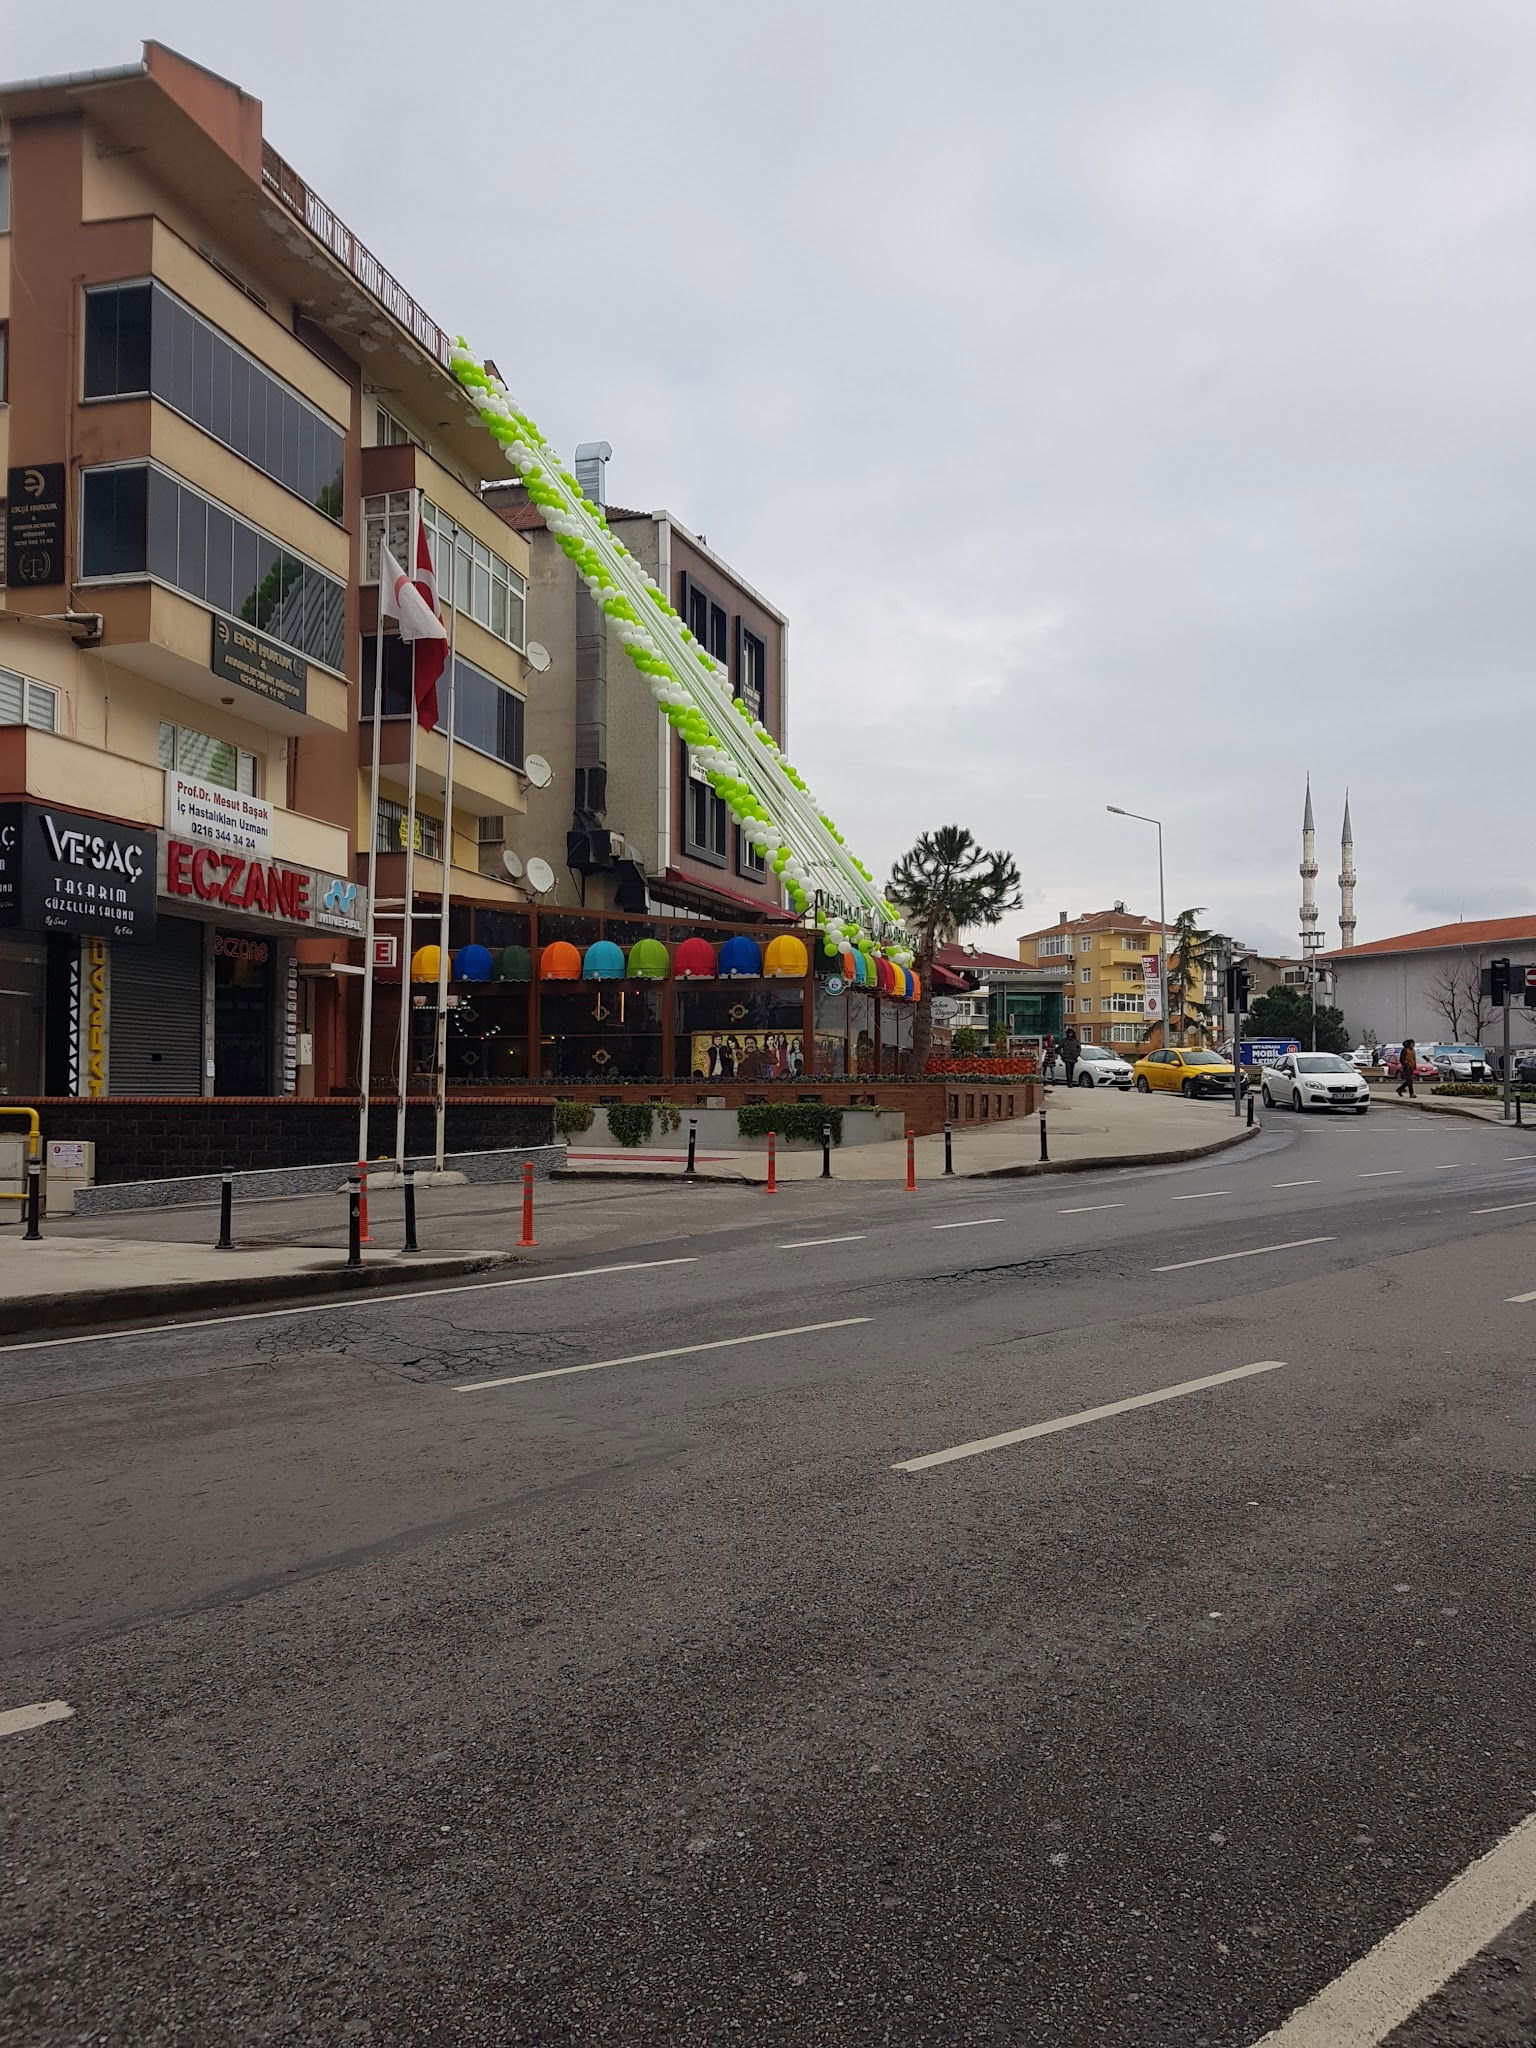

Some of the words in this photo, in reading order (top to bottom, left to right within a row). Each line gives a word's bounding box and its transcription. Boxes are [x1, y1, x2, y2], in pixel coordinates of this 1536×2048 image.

[177, 796, 186, 815] İç
[188, 802, 237, 828] Hastalıkları
[239, 818, 268, 836] Uzmanı
[213, 792, 240, 811] Mesut
[242, 801, 268, 820] Başak
[191, 822, 213, 838] 0216
[215, 829, 231, 842] 344
[233, 834, 243, 847] 34
[245, 837, 256, 849] 24
[54, 877, 127, 904] TASARIM
[168, 840, 310, 920] ECZANE
[44, 897, 96, 915] GÜZELLİK
[99, 905, 134, 921] SALONU
[319, 912, 362, 931] MINERAL
[214, 934, 269, 962] eczane
[375, 943, 389, 961] E
[1252, 1048, 1281, 1058] MOBİL
